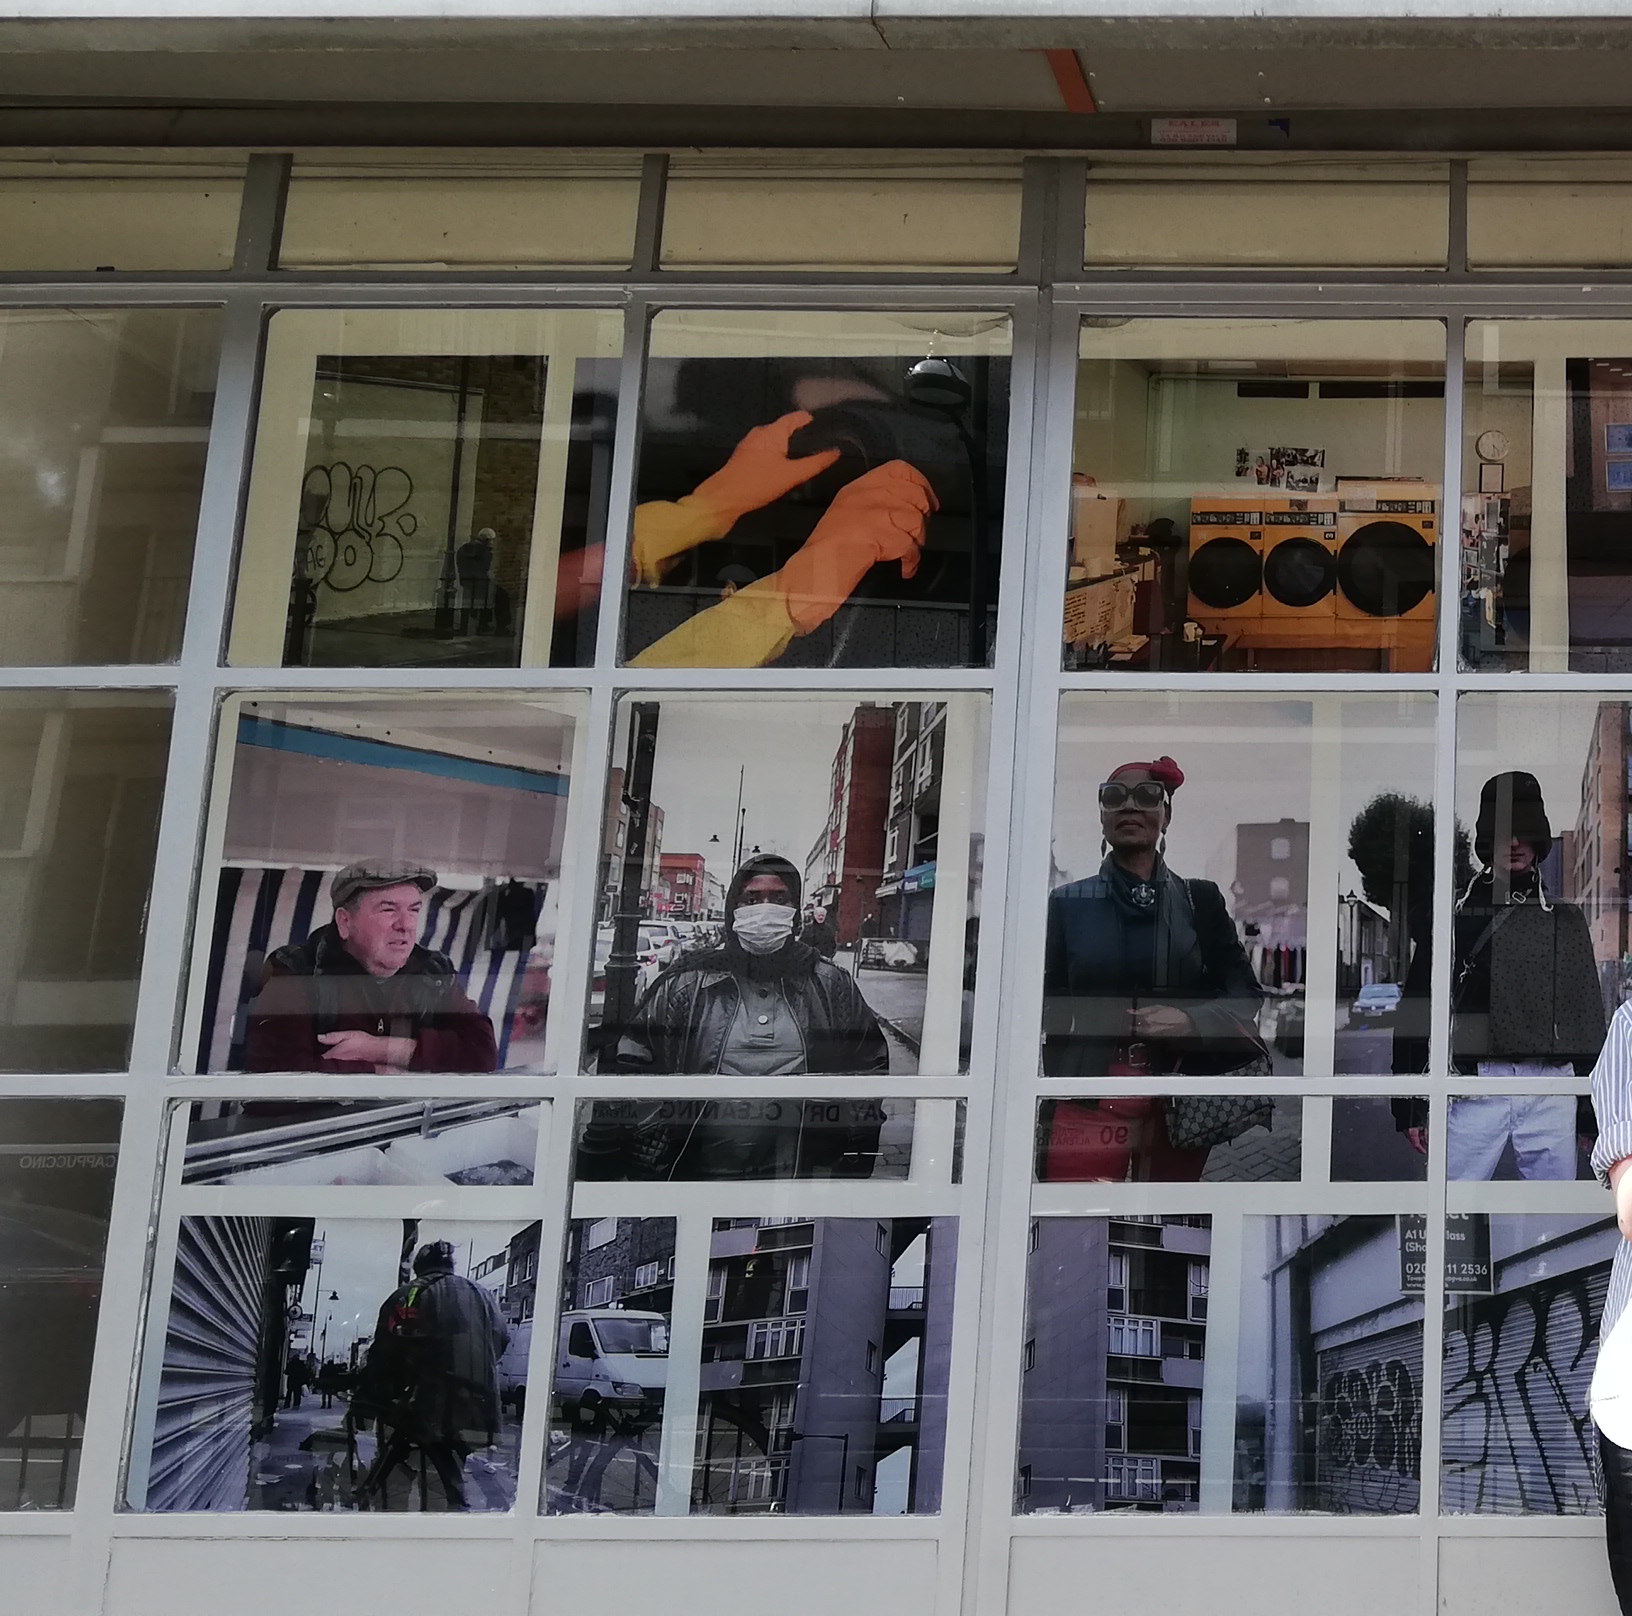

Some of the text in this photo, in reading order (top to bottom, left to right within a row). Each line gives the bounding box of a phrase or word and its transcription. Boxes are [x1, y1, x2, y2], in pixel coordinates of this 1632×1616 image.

[1405, 1230, 1466, 1241] A1 lass
[1405, 1242, 1427, 1253] (Sho
[1461, 1264, 1488, 1275] 2536
